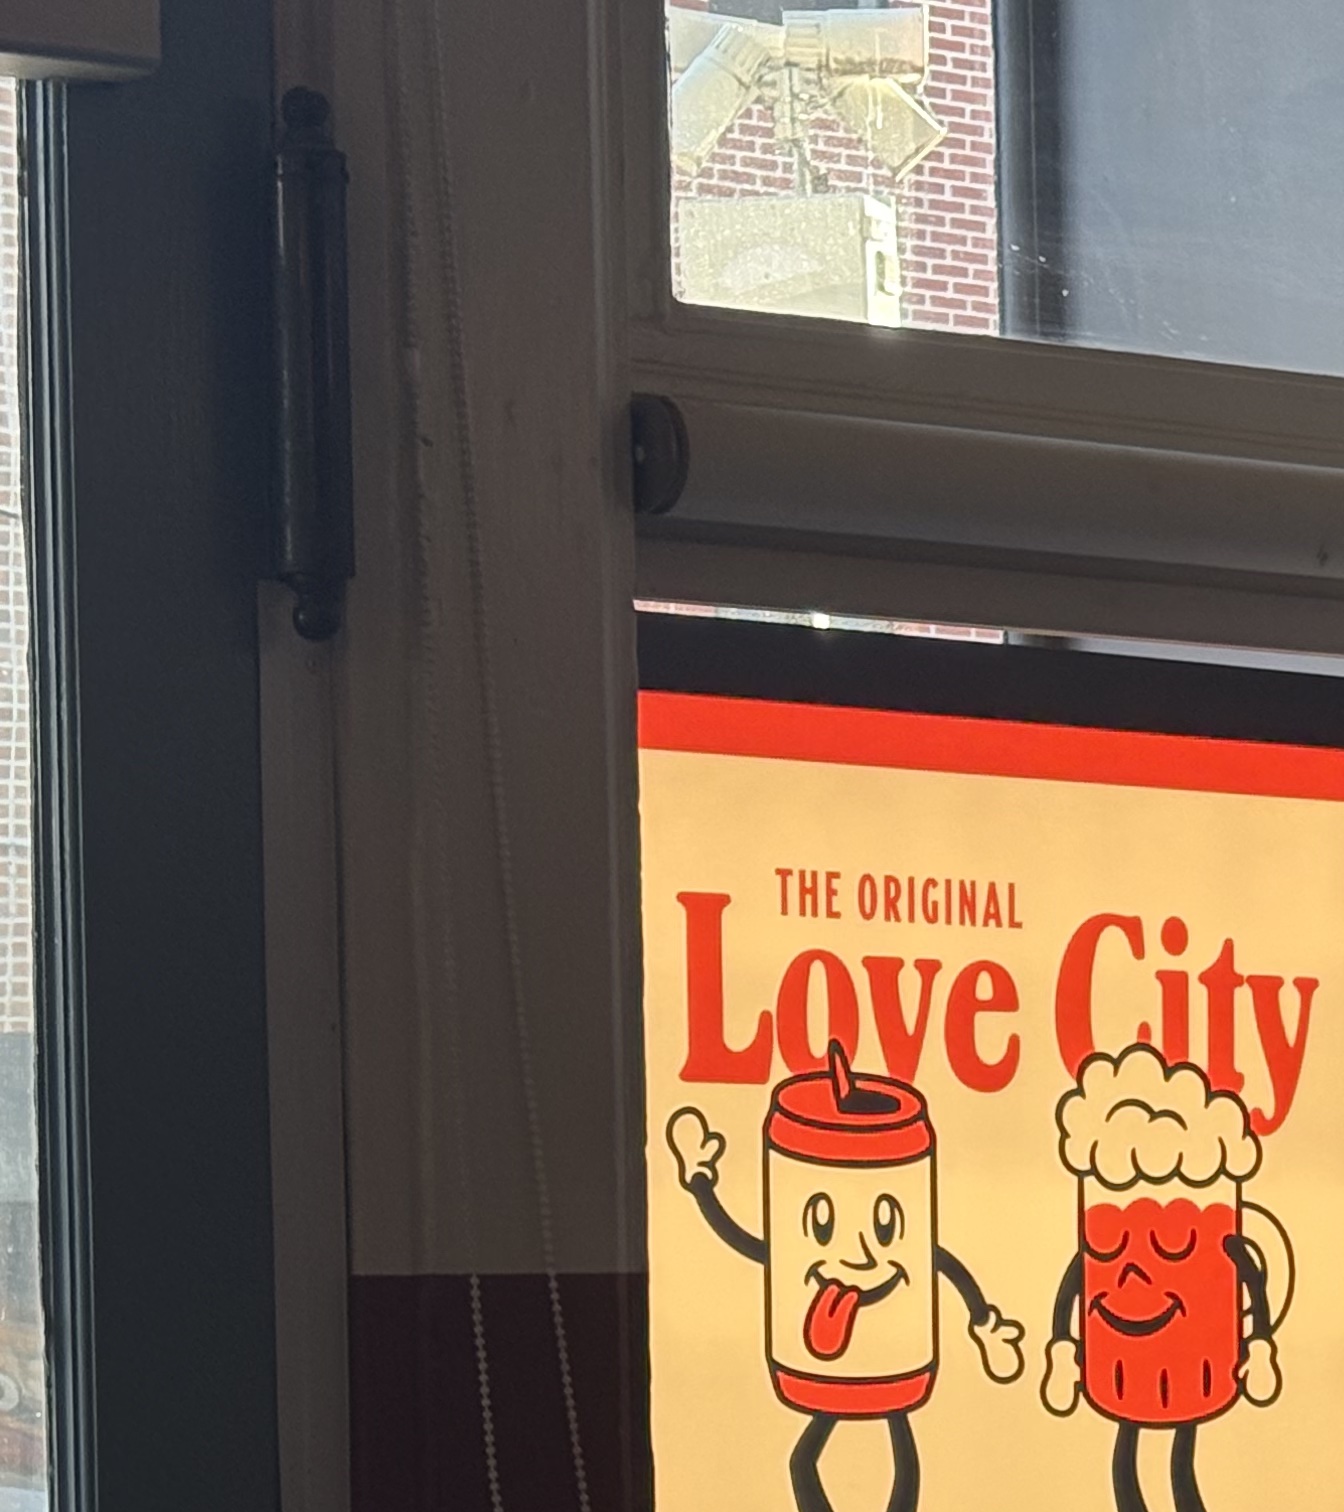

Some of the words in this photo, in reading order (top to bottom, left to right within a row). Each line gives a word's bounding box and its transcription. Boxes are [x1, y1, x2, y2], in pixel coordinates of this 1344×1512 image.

[774, 867, 842, 921] THE
[857, 873, 1024, 930] ORIGINAL
[676, 891, 1022, 1093] Love
[1055, 912, 1320, 1138] City
